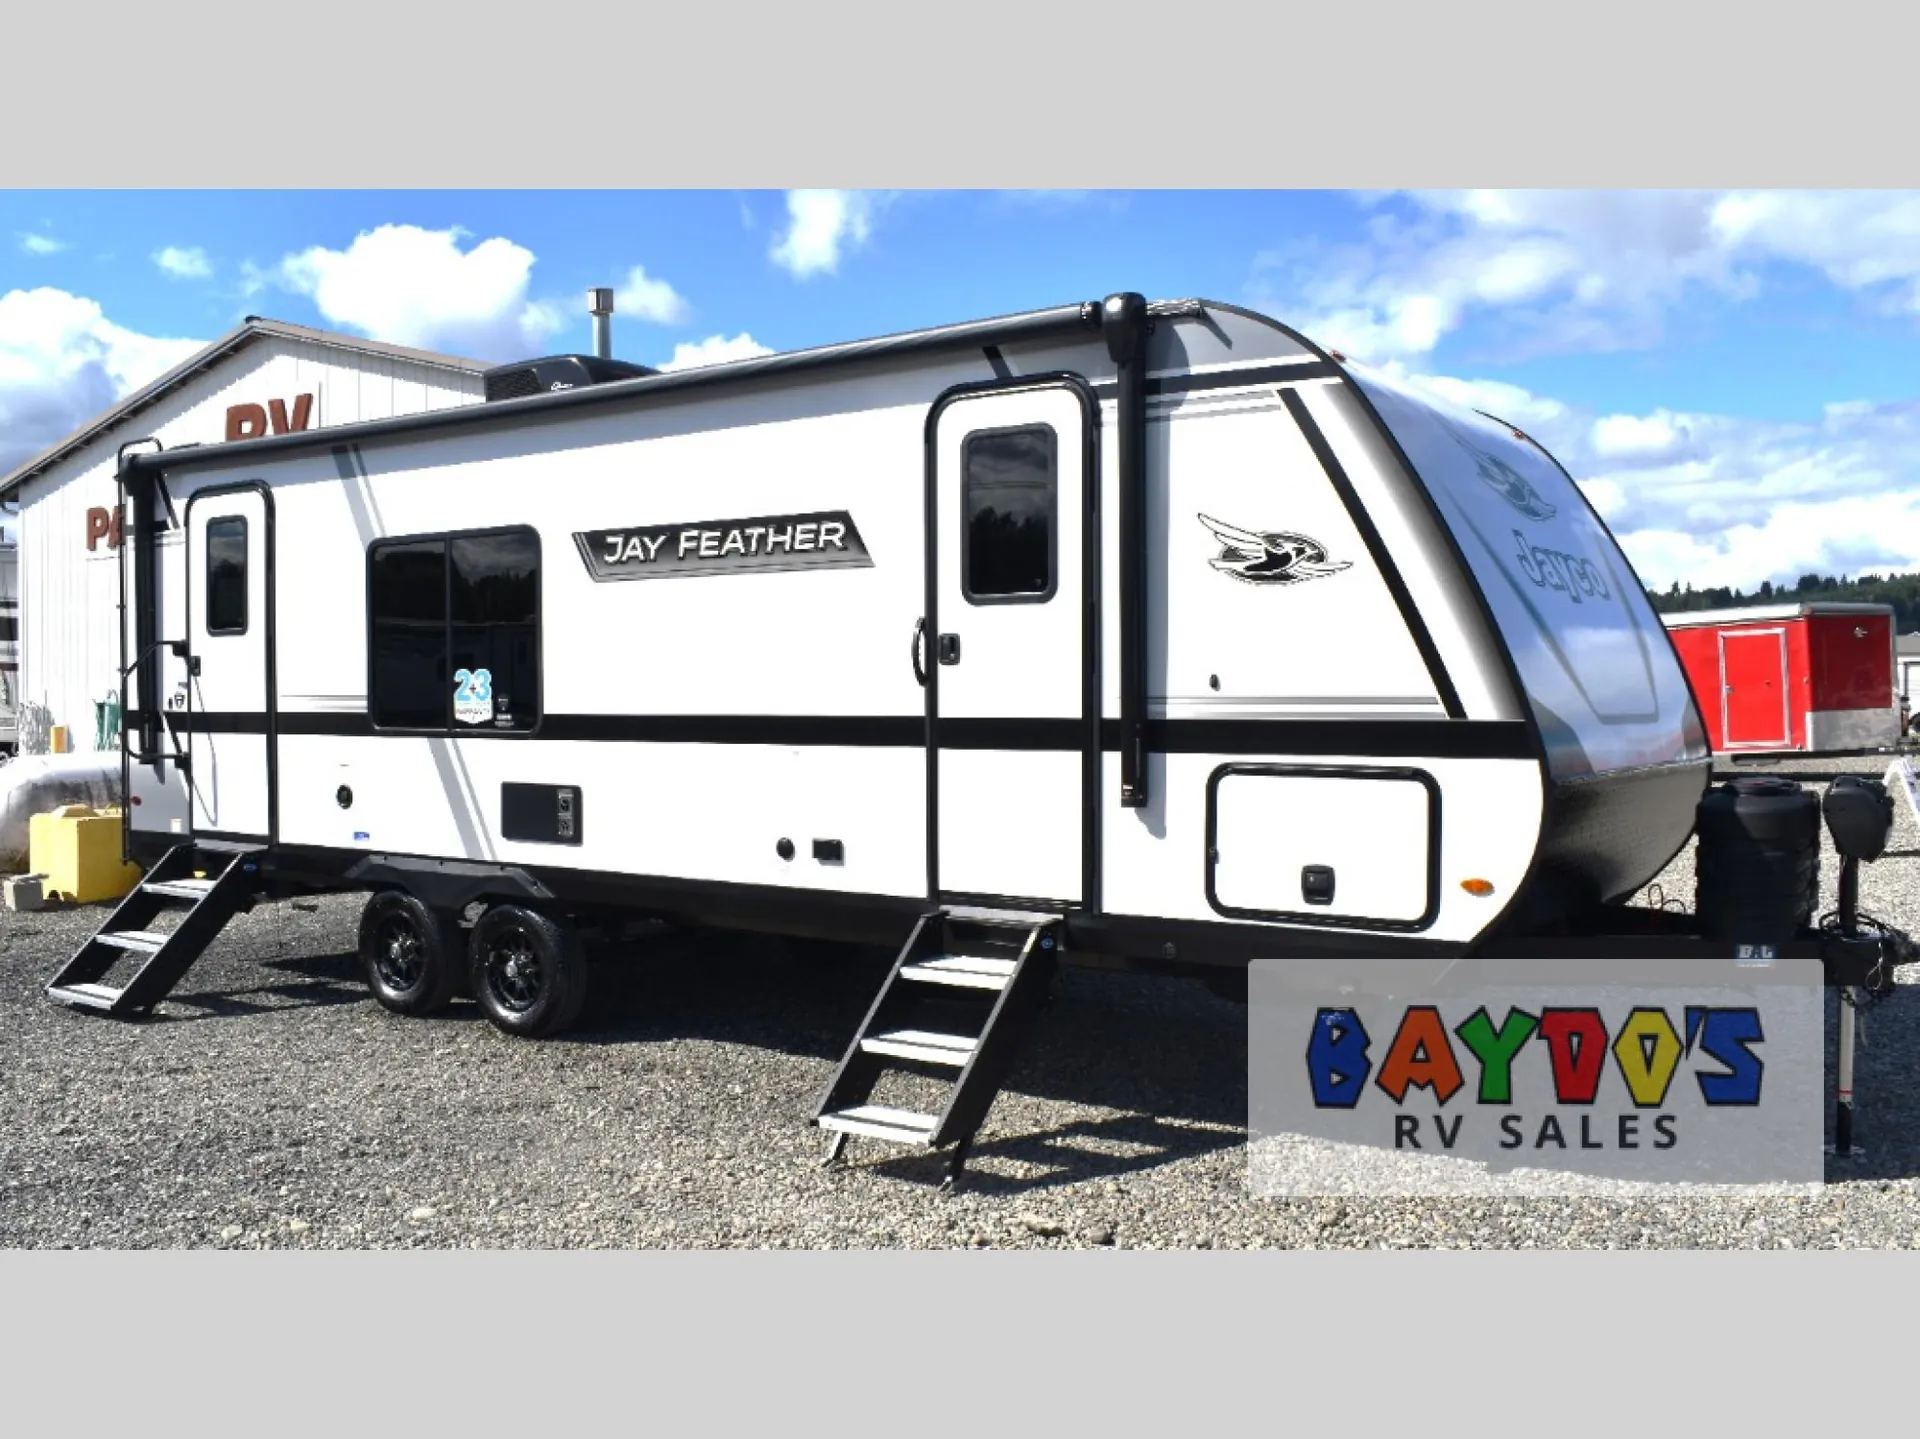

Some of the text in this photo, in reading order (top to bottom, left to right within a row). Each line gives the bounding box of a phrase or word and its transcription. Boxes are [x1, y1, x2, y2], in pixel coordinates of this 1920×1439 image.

[225, 393, 313, 441] RV
[603, 520, 848, 564] JAY FEATHER
[1511, 529, 1611, 604] Jayco
